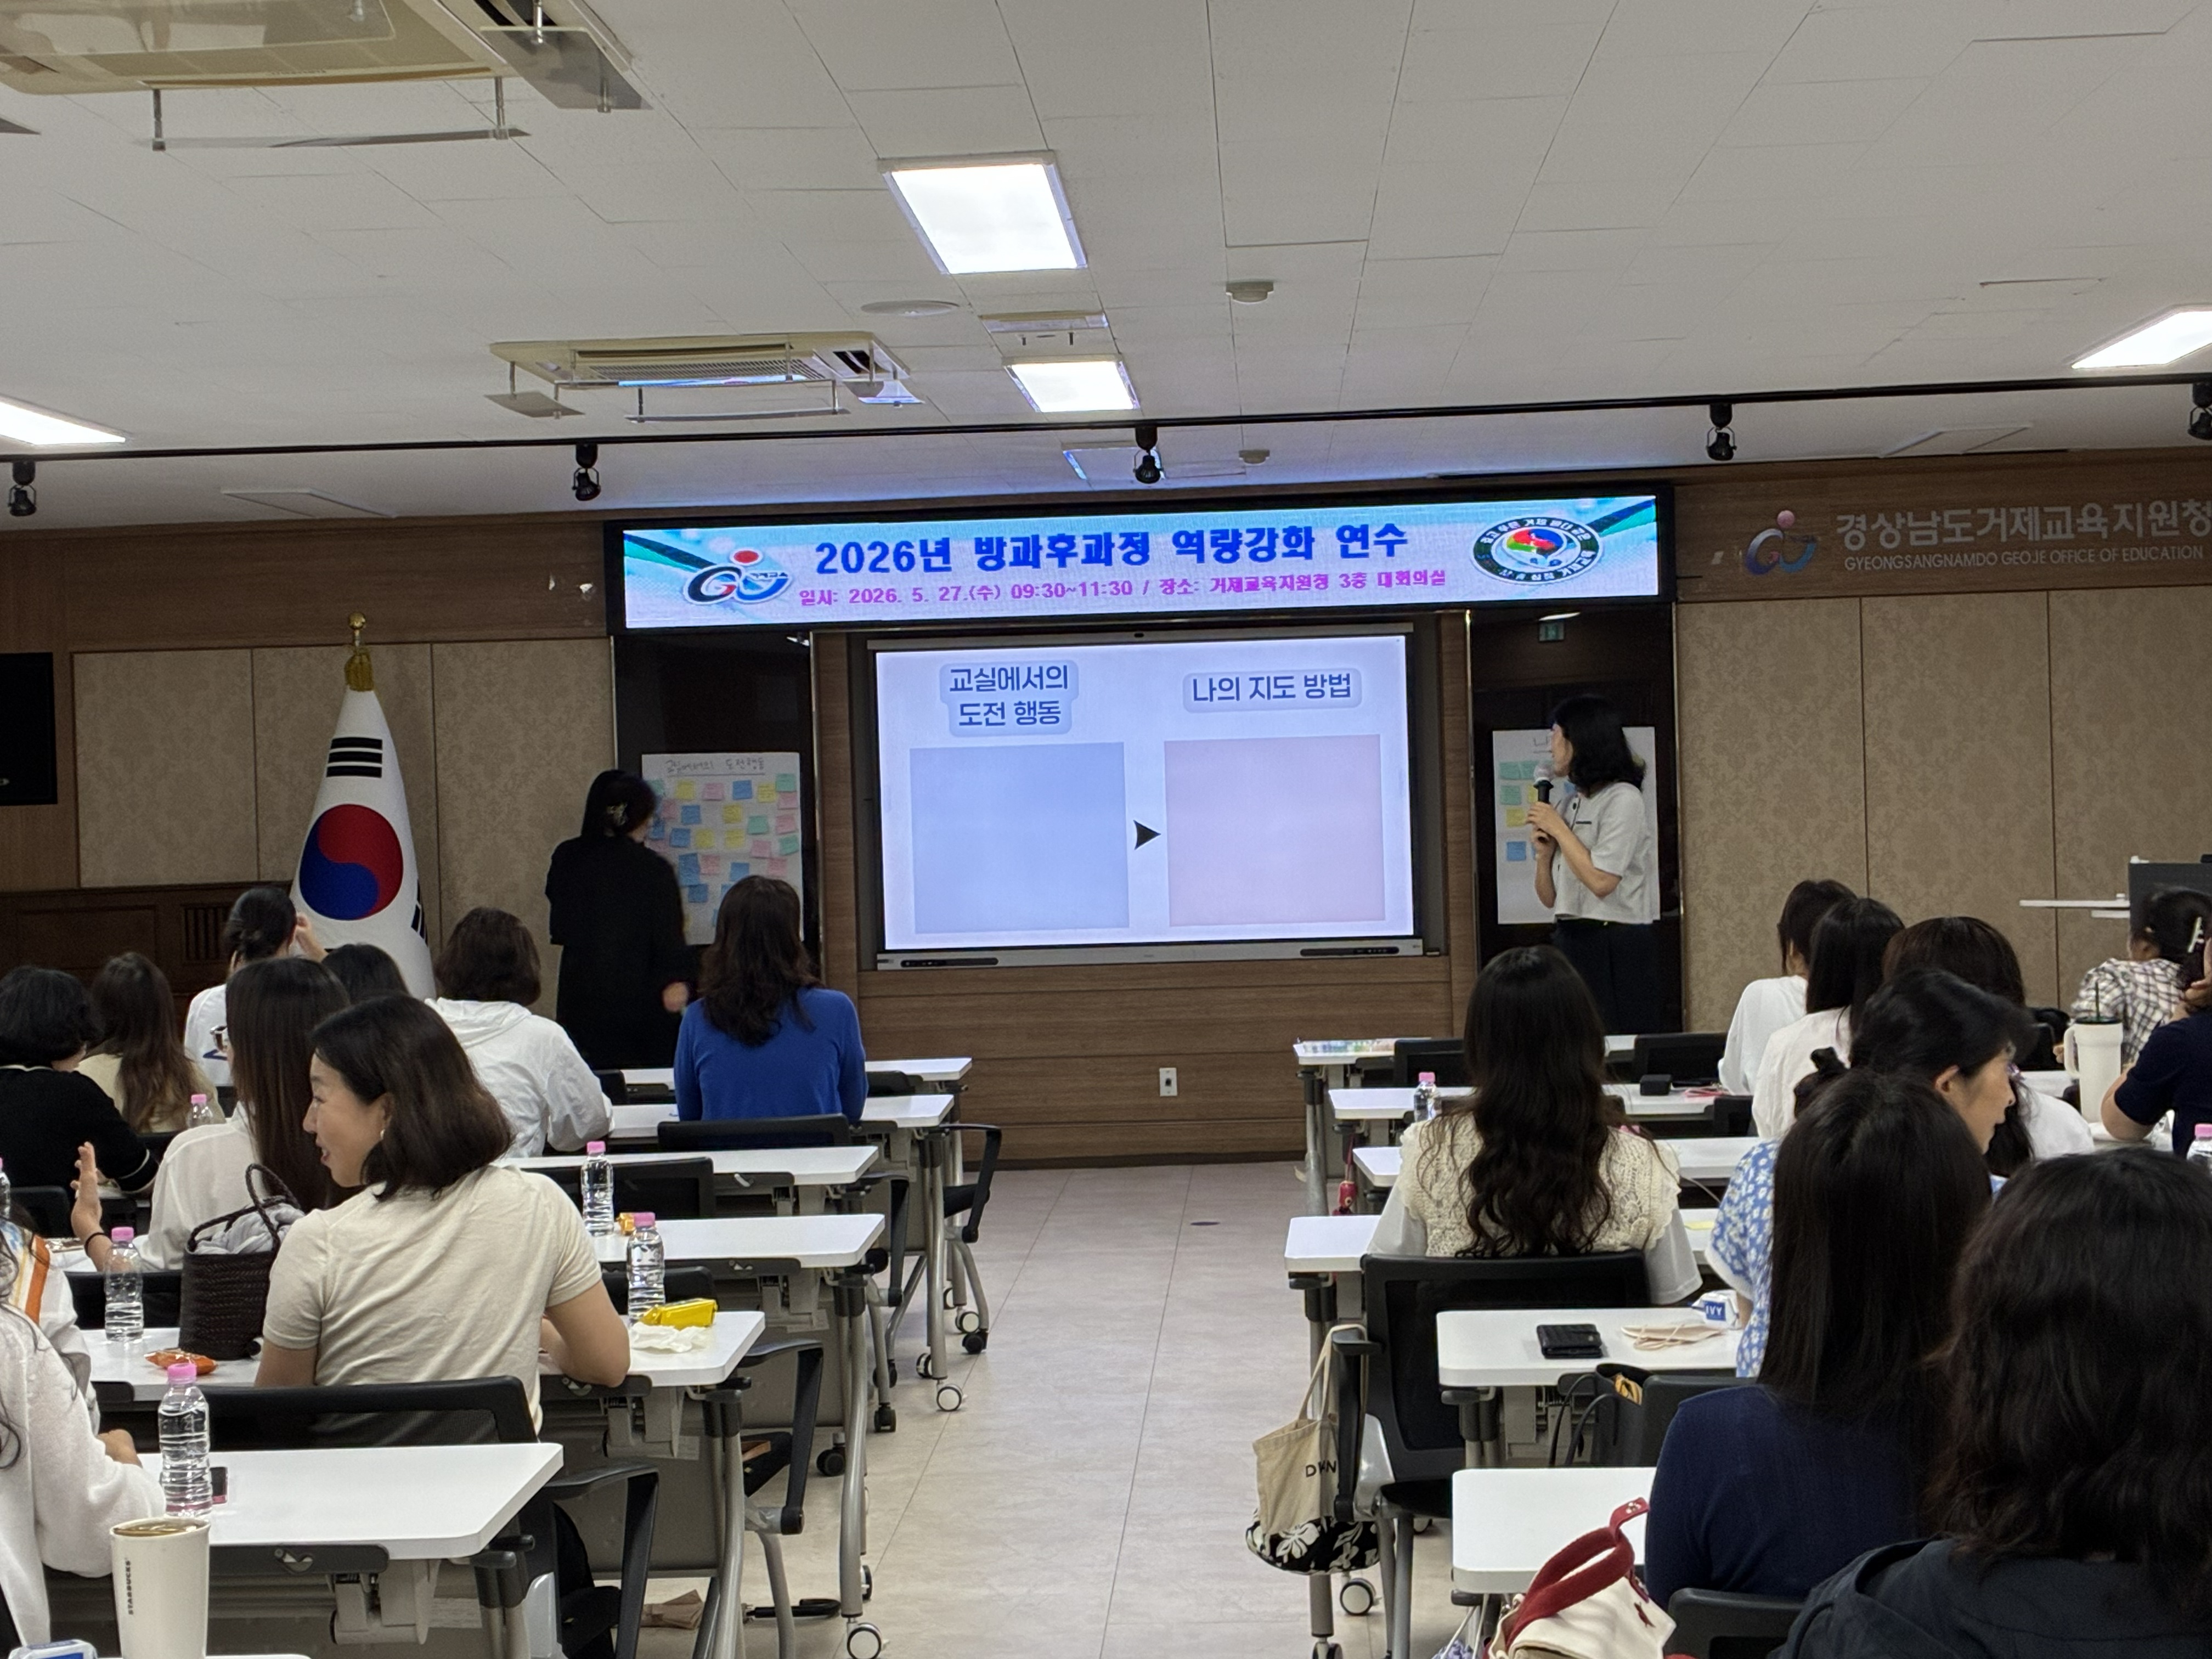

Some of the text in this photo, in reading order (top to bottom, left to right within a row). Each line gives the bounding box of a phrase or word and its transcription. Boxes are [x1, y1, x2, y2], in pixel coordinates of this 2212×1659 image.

[1836, 499, 2212, 550] 경상남도거제교육지원청
[815, 523, 1408, 574] 2026년 방과후과정 역량강화 연수
[1844, 545, 2203, 571] GYEONGSANGNAMDO GEOJE OFFICE OF EDUCATION
[799, 589, 838, 606] 일시:
[849, 588, 902, 603] 2026.
[912, 587, 928, 602] 5.
[938, 585, 1001, 601] 27.(수)
[1011, 580, 1132, 599] 09:30~11:30
[1159, 578, 1199, 595] 장소:
[1339, 572, 1367, 589] 3층
[1378, 569, 1445, 588] 대회의실
[950, 665, 1068, 692] 교실에서의
[1193, 673, 1351, 702] 나의 지도 방법
[959, 701, 1061, 727] 도전 행동
[1706, 1305, 1722, 1316] IVY
[125, 1560, 134, 1615] STARBUCKS
